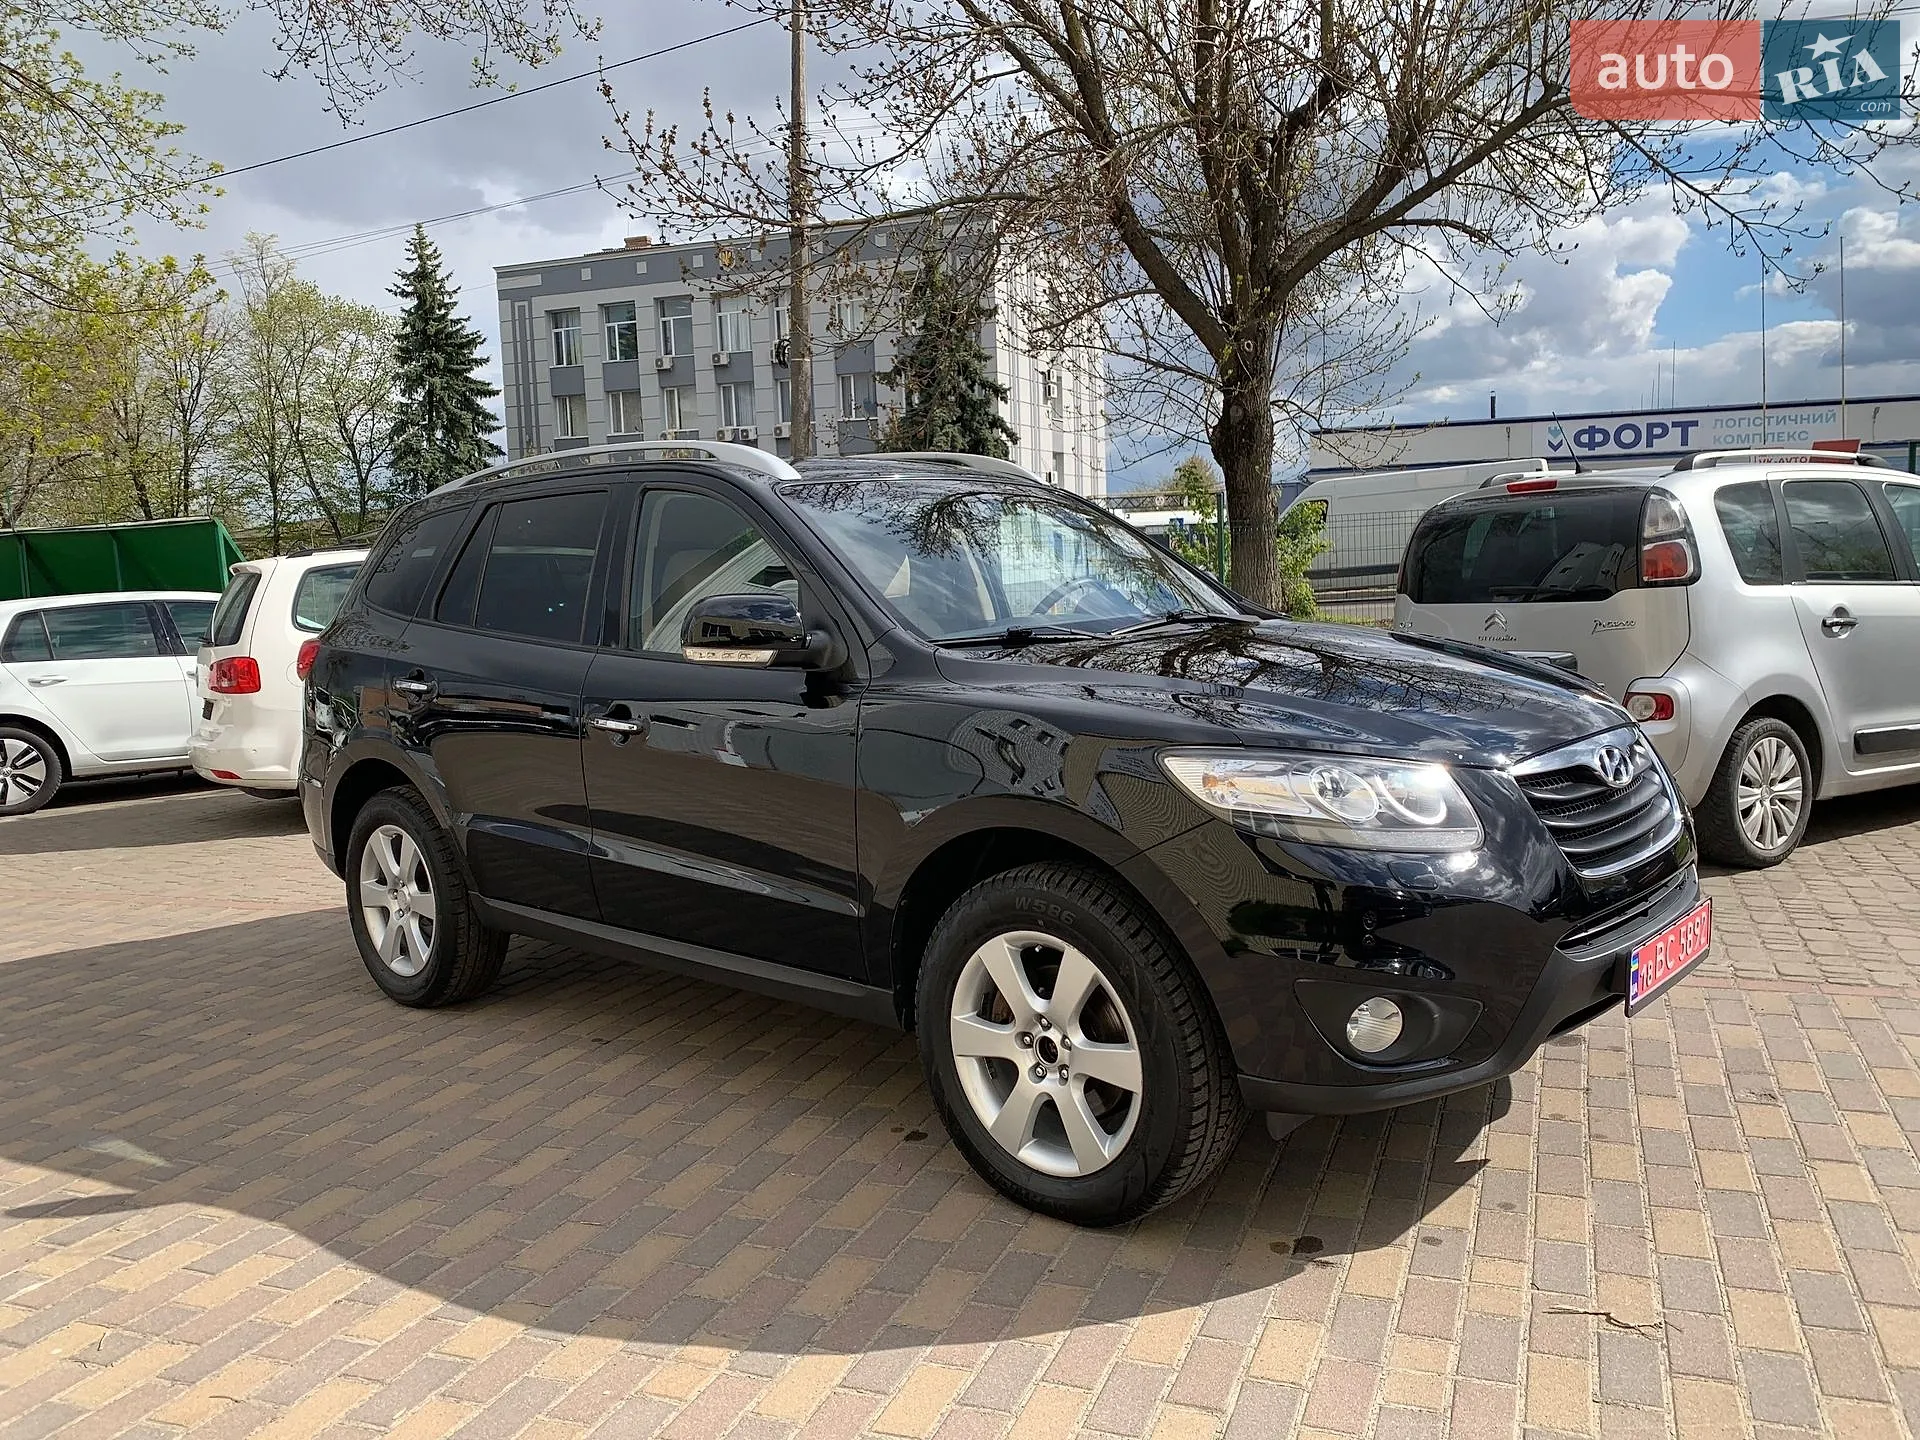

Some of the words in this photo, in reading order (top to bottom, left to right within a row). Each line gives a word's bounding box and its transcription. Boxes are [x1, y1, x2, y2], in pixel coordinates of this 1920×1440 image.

[1712, 409, 1837, 429] ЛОГІСТИЧНИЙ
[1573, 420, 1699, 451] ФОРТ
[1712, 430, 1809, 445] КОМПЛЕКС
[1655, 934, 1675, 980] BC
